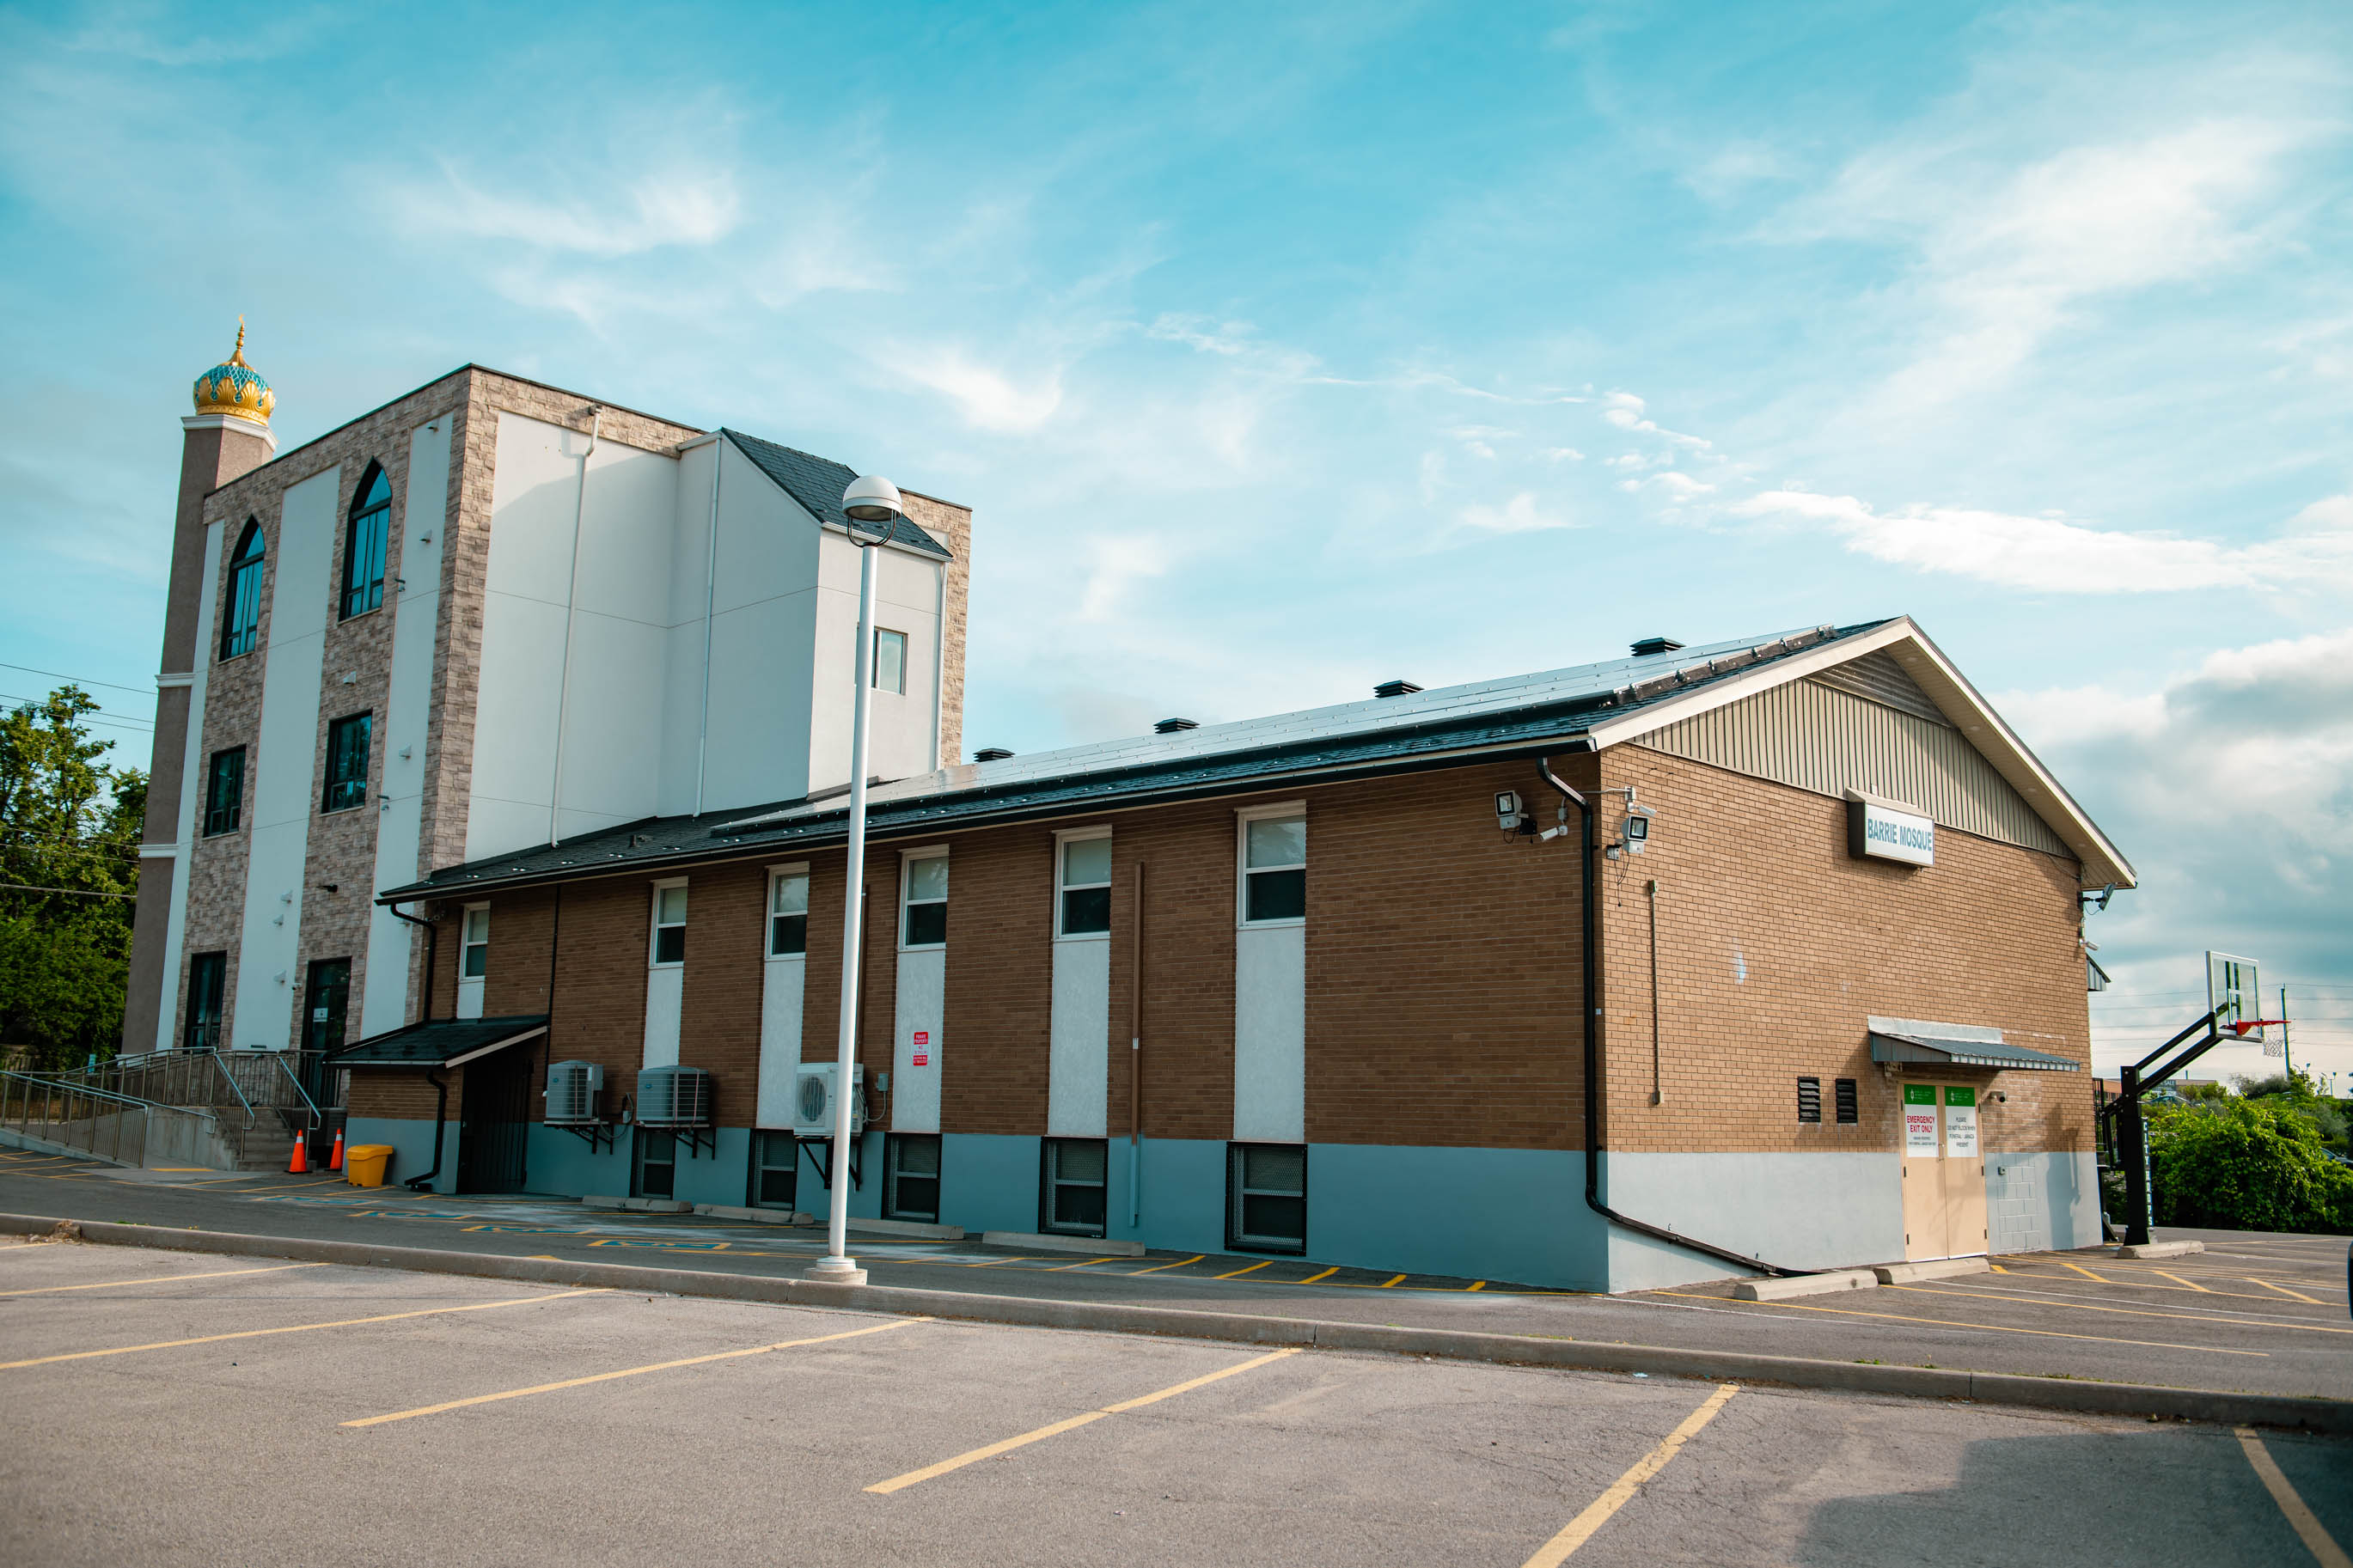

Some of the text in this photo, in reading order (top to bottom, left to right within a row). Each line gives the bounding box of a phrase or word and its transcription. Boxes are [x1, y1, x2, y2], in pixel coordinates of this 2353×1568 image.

[1867, 818, 1932, 851] BARRIE MOSQUE
[1907, 1115, 1935, 1124] EMERGENCY
